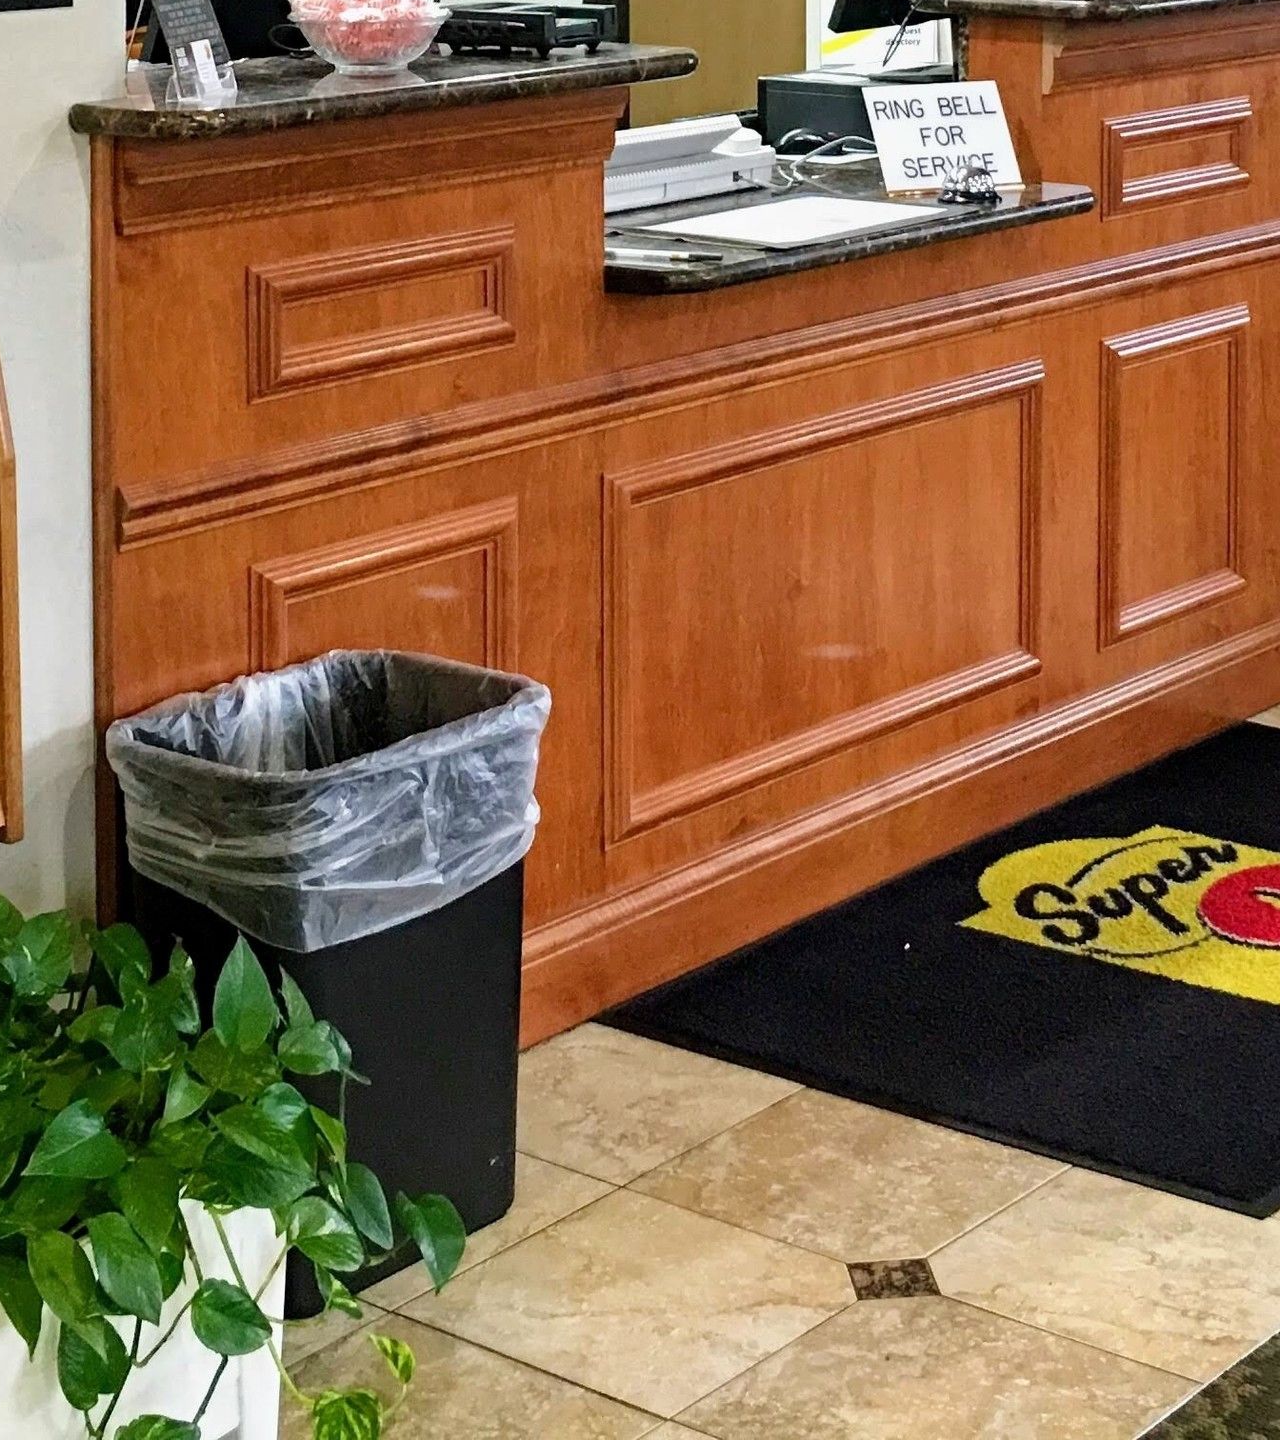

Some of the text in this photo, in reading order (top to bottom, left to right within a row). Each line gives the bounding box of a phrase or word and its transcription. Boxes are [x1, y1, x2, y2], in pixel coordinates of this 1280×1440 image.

[873, 95, 997, 120] RING BELL
[920, 125, 967, 147] FOR
[1014, 839, 1239, 949] Super
